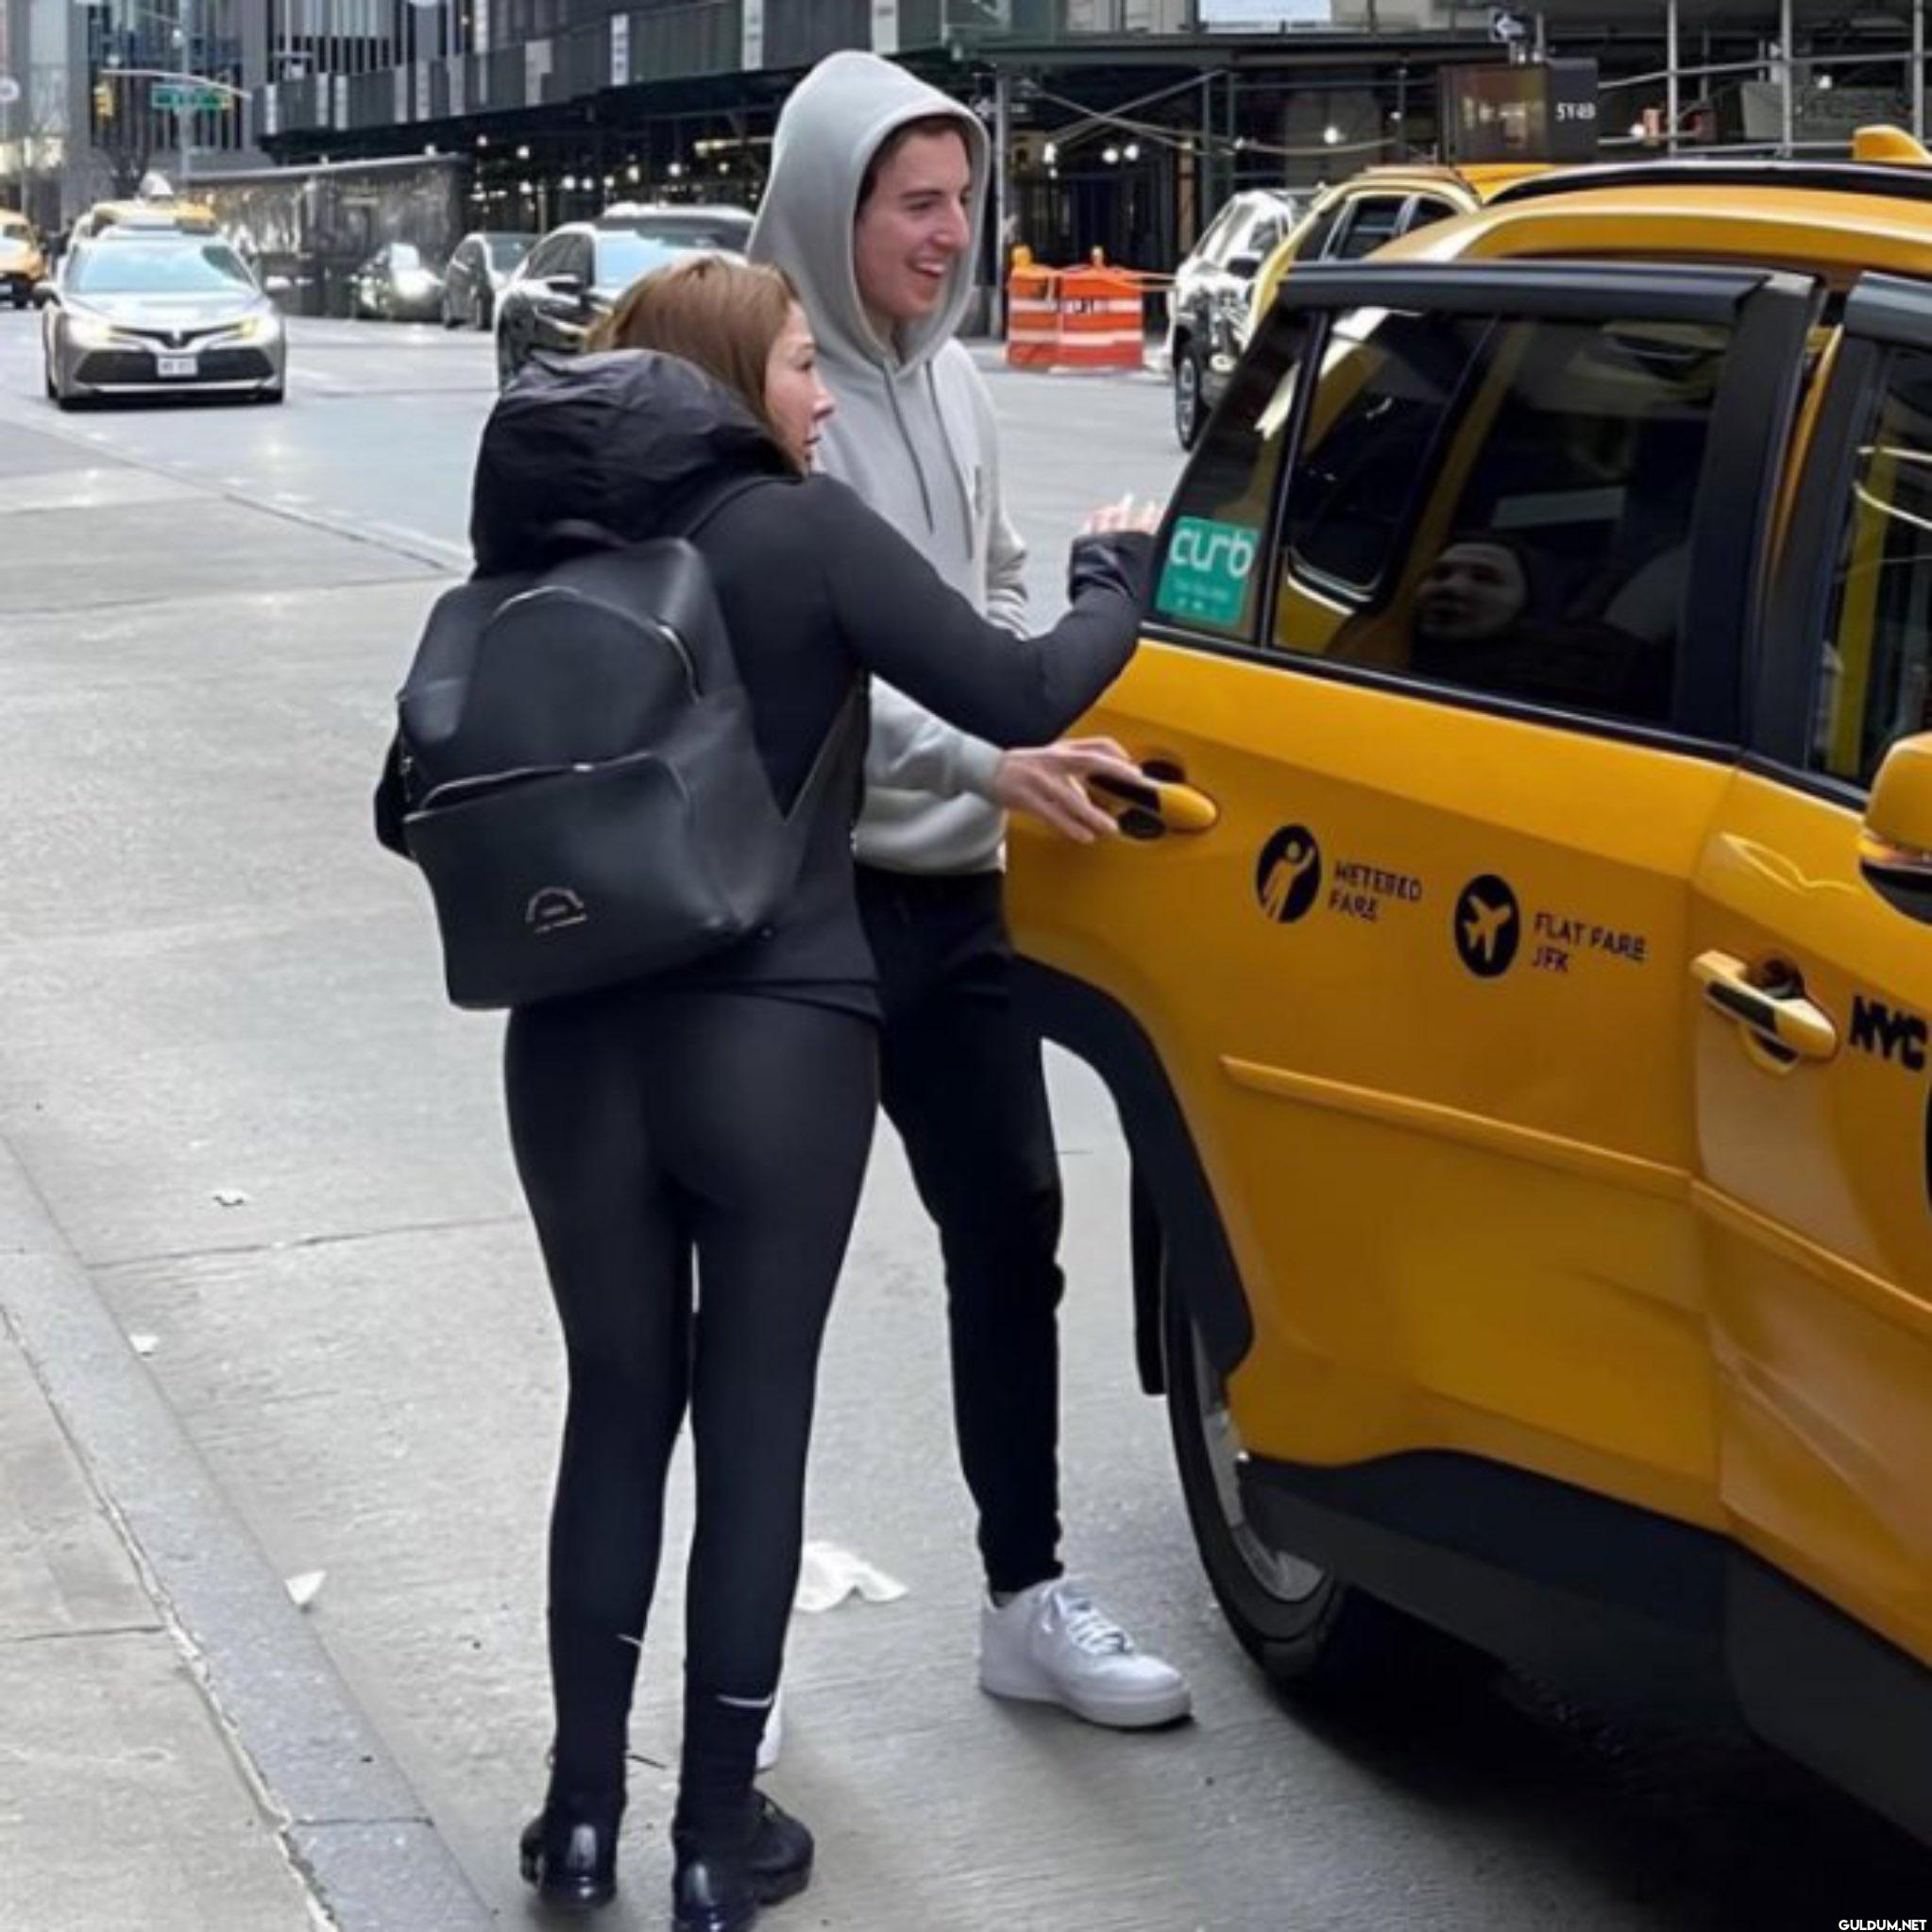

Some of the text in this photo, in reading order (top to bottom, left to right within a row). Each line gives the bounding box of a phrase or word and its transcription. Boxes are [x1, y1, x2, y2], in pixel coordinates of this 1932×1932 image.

[1170, 528, 1254, 579] curb
[1329, 890, 1378, 922] FARE
[1531, 946, 1569, 974] JFK
[1534, 913, 1647, 961] FLAT FARE
[1849, 994, 1927, 1071] NYC
